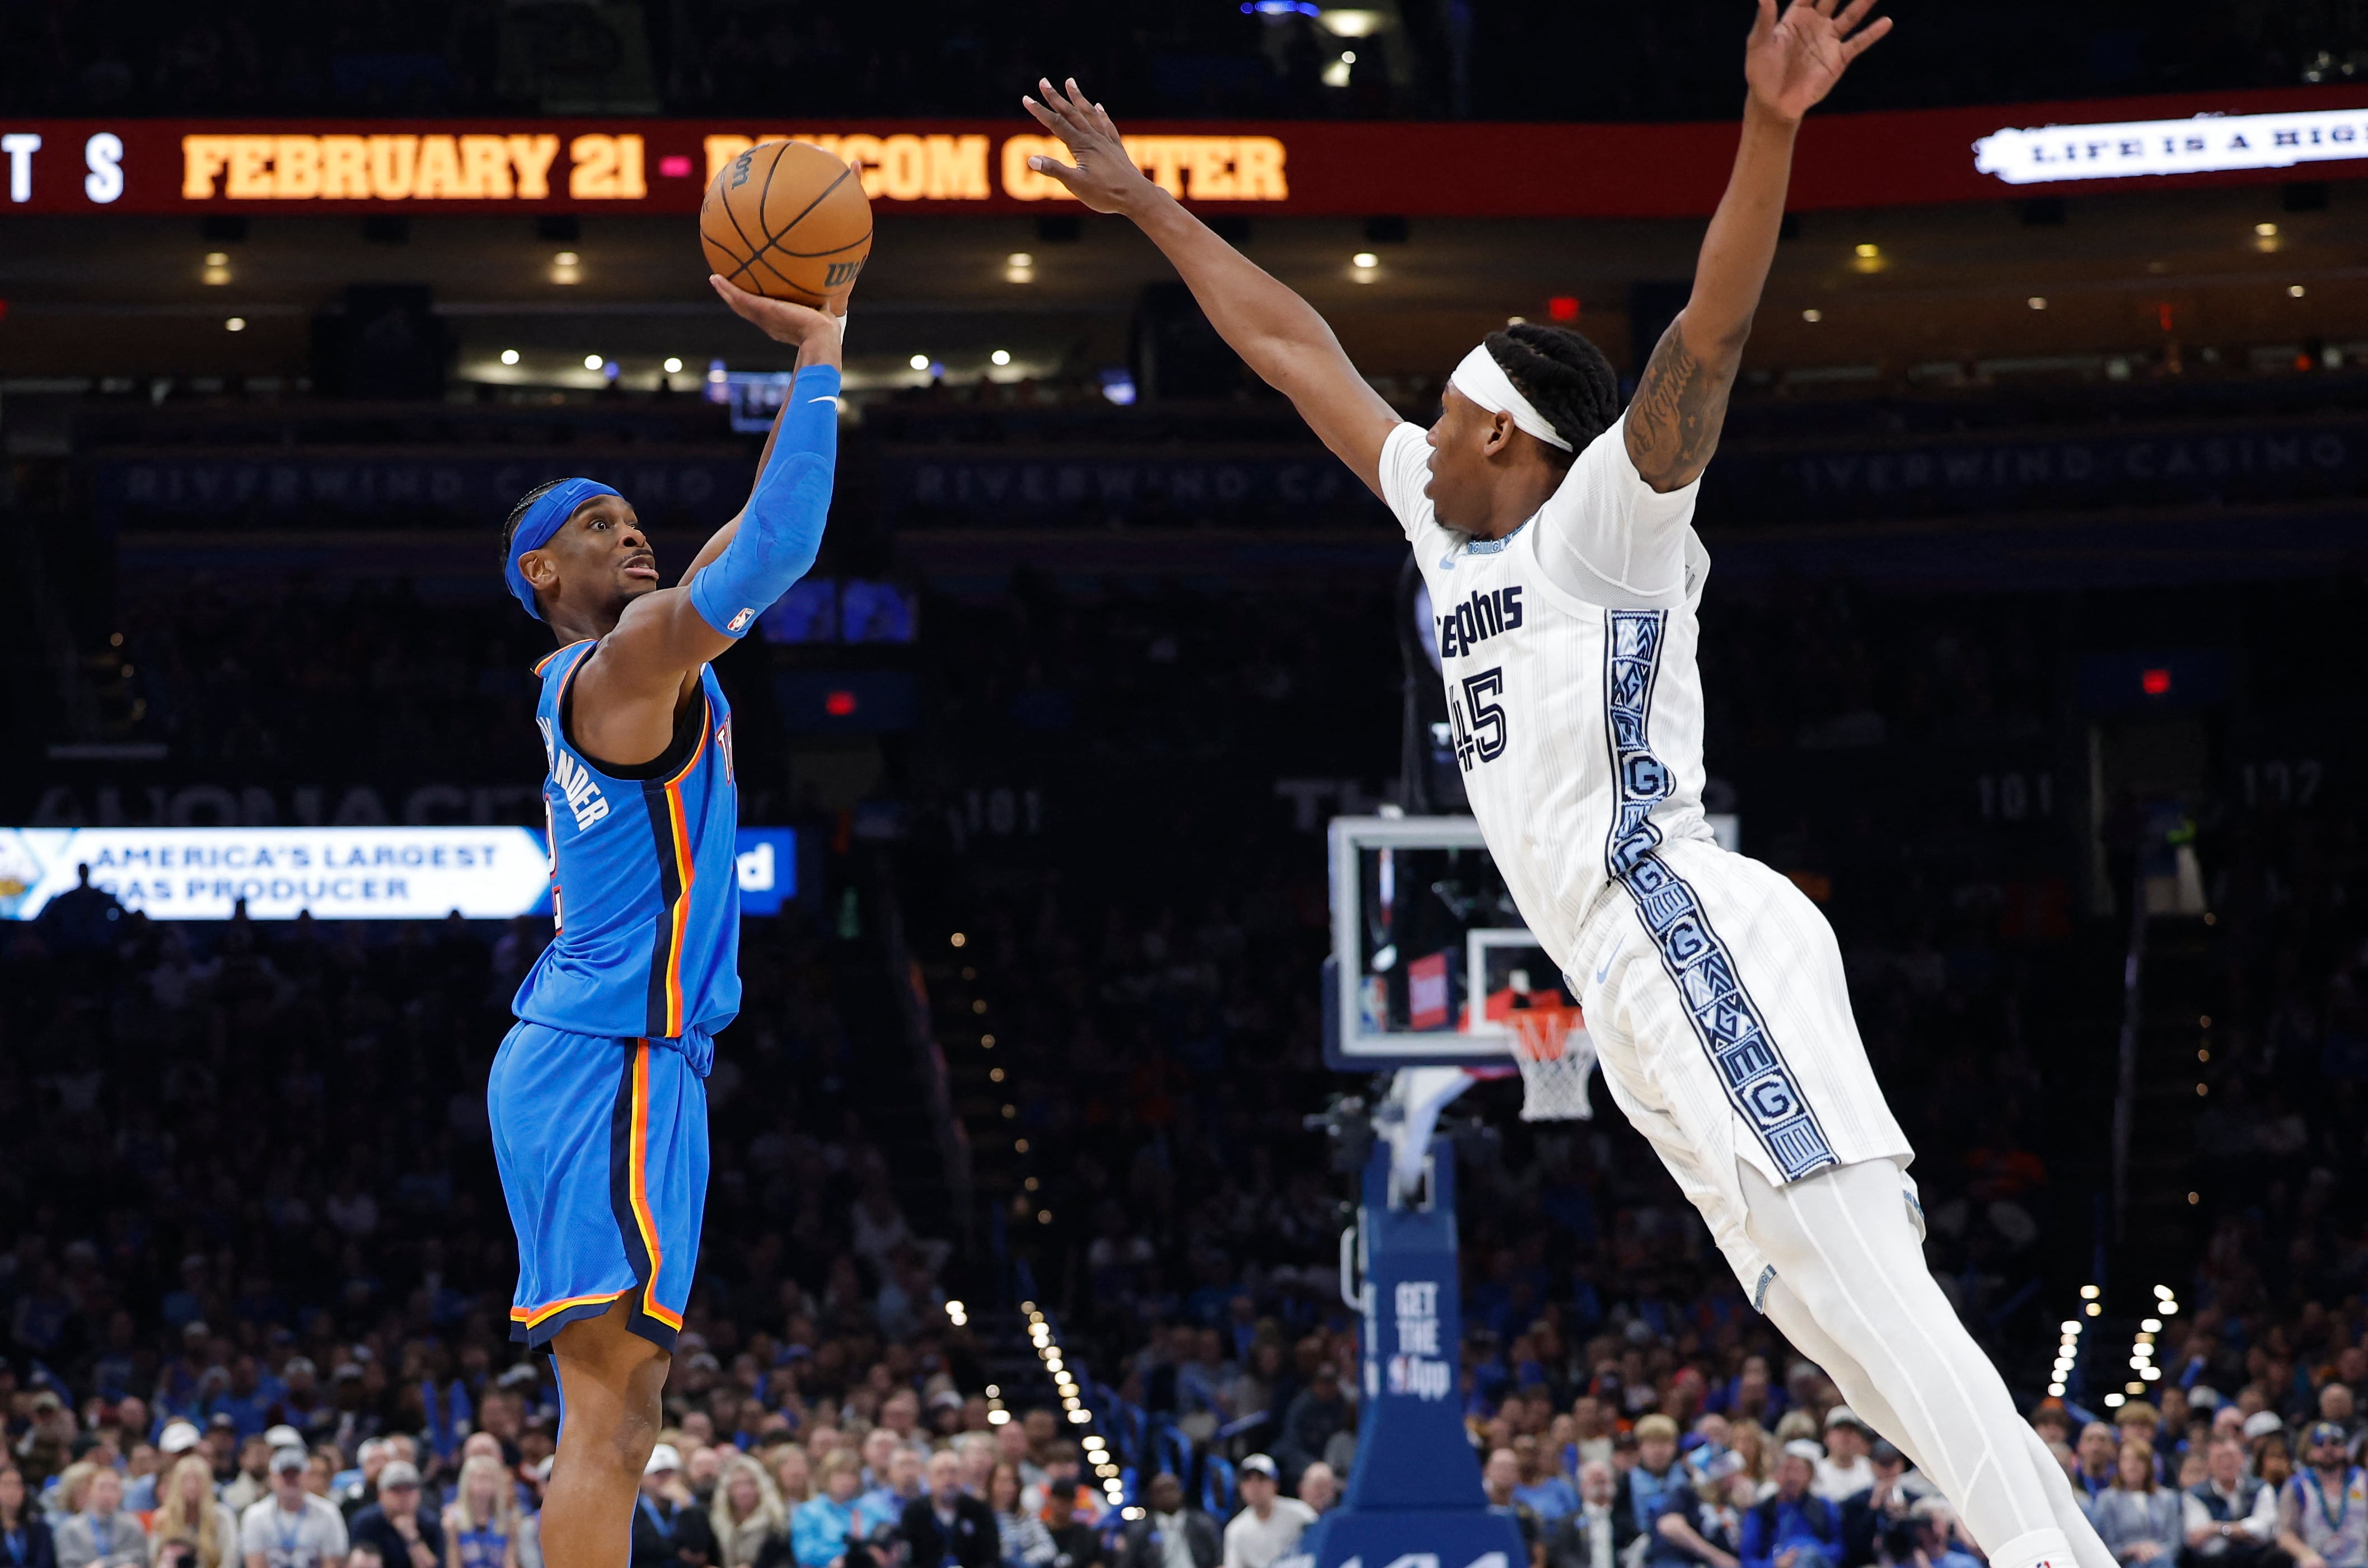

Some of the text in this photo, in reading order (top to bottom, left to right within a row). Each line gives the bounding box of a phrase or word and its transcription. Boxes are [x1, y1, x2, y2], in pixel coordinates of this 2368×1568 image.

[2032, 124, 2368, 163] LIFE IS A HIG
[182, 134, 558, 200] FEBRUARY
[569, 134, 647, 200] 21
[1786, 446, 2093, 494] IVERWIND
[96, 845, 497, 868] AMERICA'S LARGEST
[186, 877, 411, 901] PRODUCER
[1395, 1281, 1439, 1316] GET
[1396, 1318, 1440, 1356] THE
